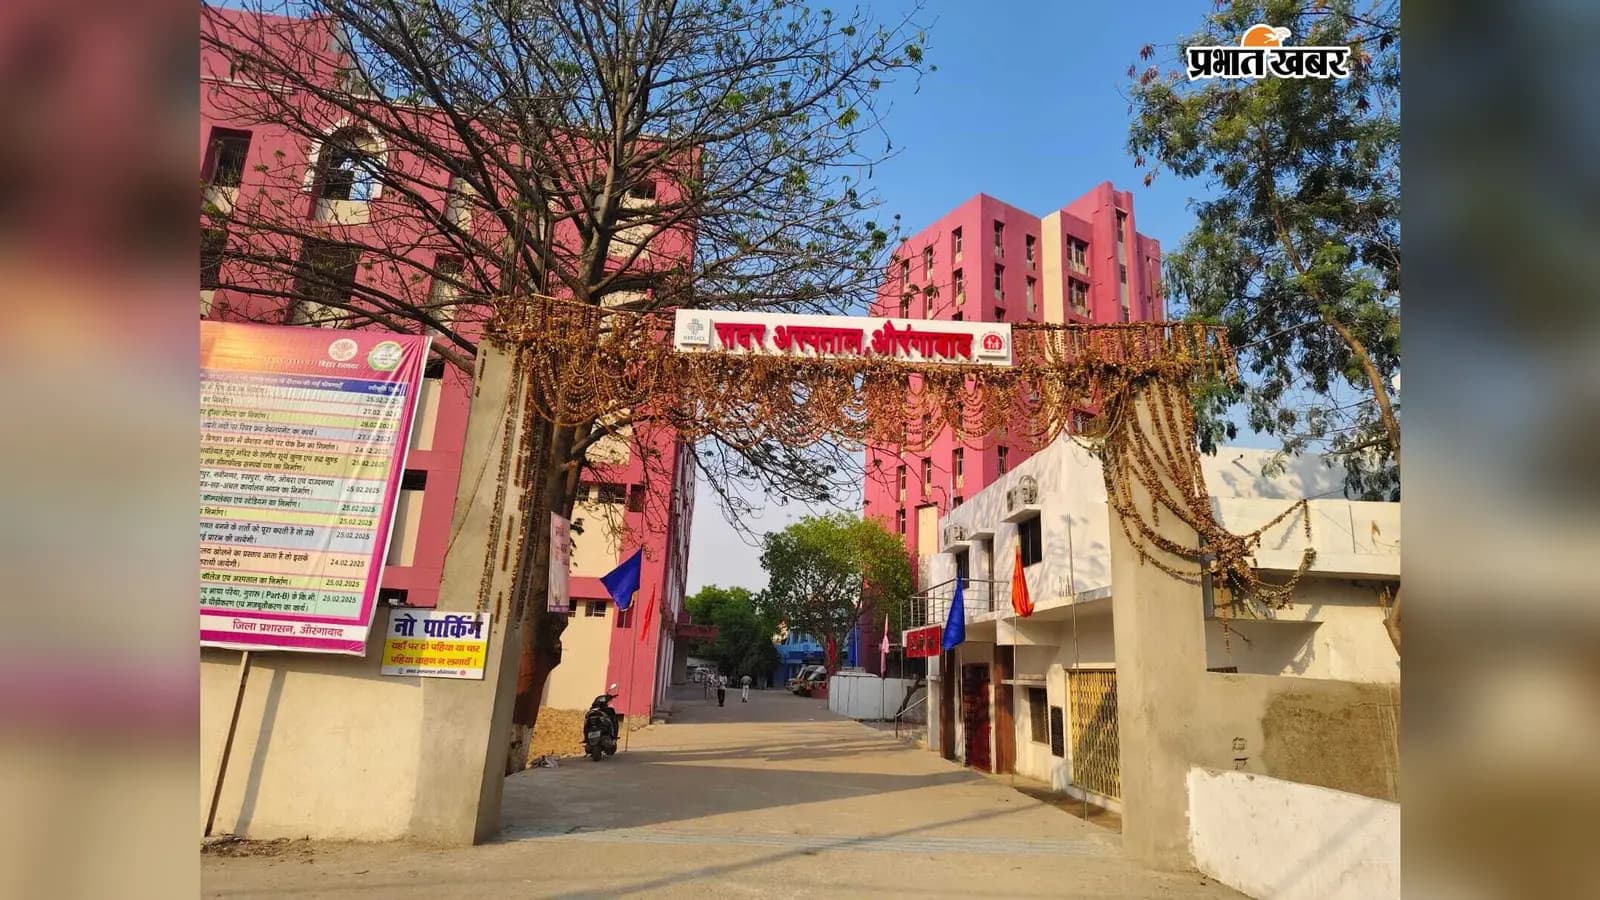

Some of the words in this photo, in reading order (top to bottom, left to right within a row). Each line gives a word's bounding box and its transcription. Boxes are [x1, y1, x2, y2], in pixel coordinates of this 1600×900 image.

[714, 322, 766, 351] सदर
[336, 531, 371, 541] 25.02.2025
[232, 618, 256, 631] जिला
[259, 622, 297, 635] प्रशासन,
[394, 613, 418, 637] नो
[424, 615, 484, 639] पार्किंग
[431, 642, 454, 652] पहिया
[455, 644, 465, 652] या
